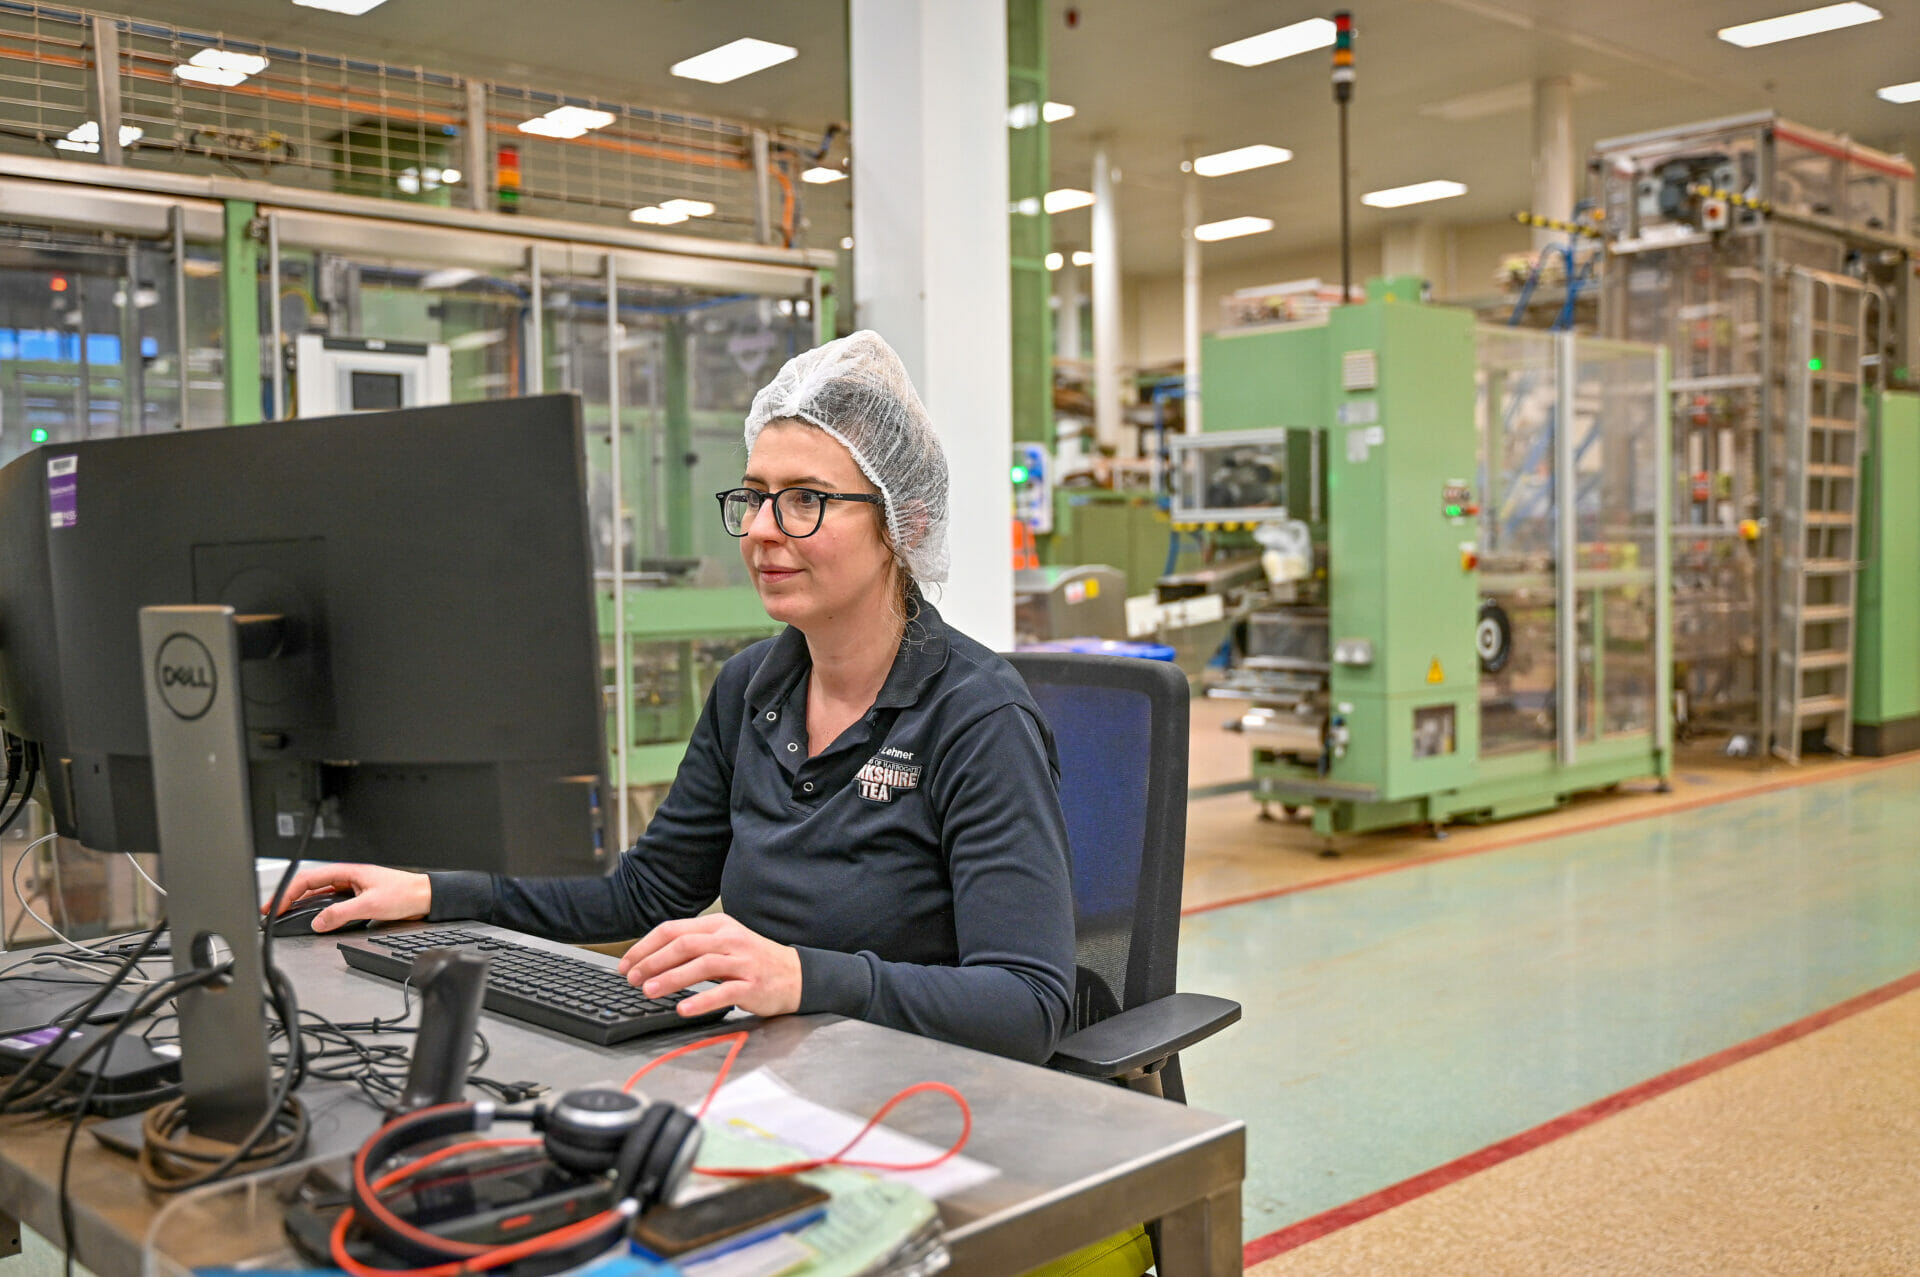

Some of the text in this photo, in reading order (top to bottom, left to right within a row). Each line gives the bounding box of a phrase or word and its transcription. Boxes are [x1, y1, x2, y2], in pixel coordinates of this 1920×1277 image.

[163, 666, 211, 688] DELL
[881, 746, 914, 760] Lehner
[861, 780, 888, 800] TEA
